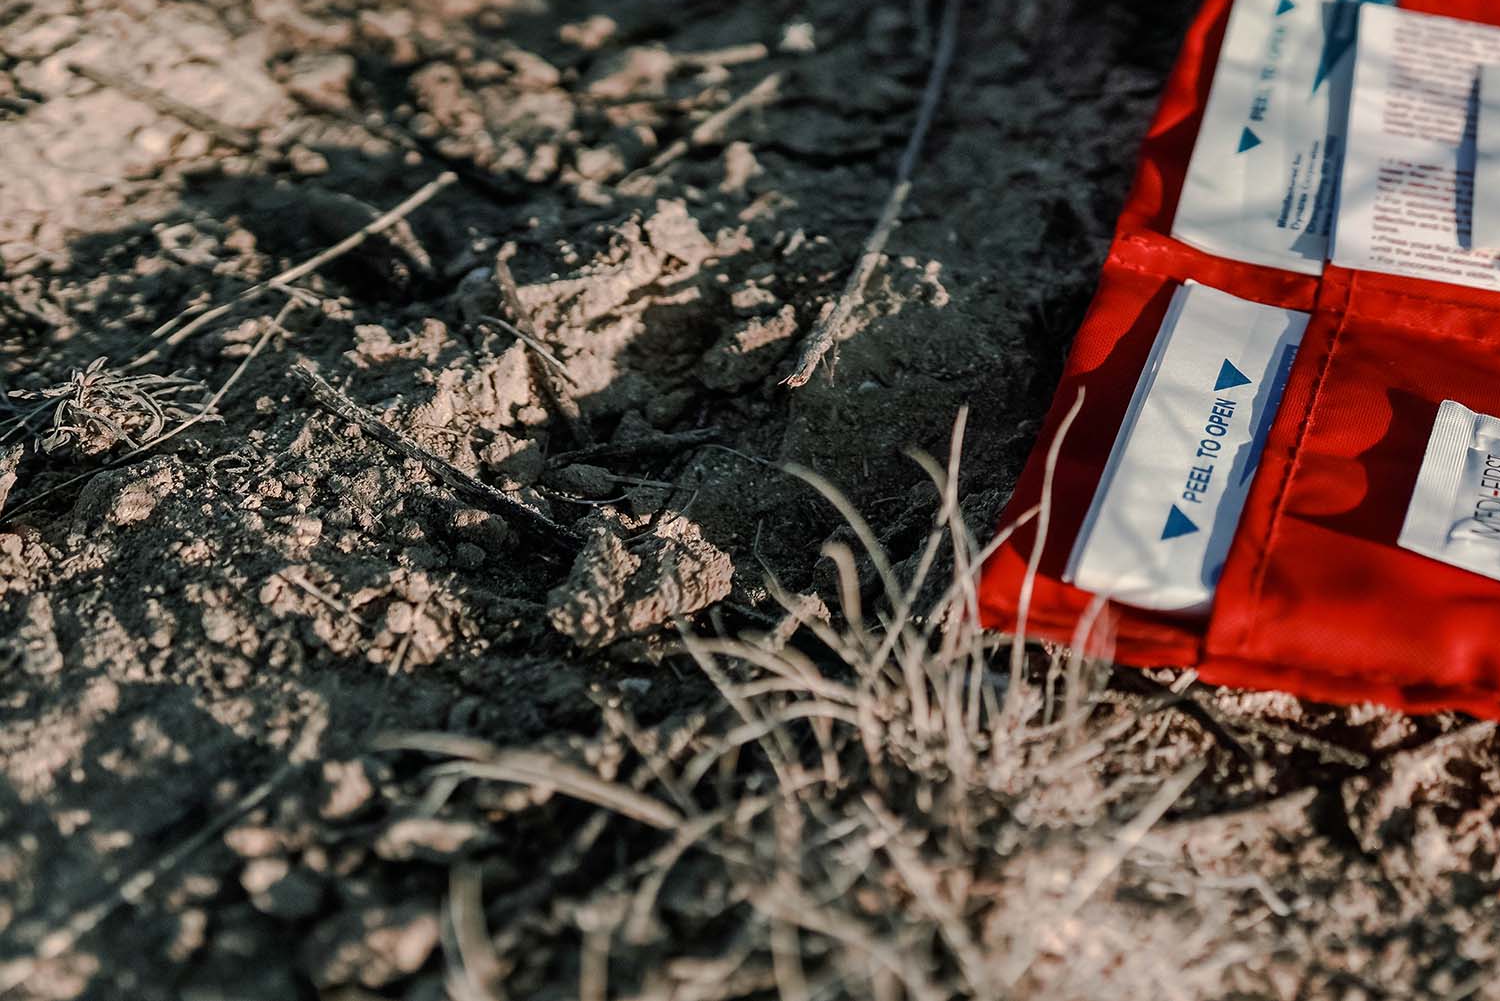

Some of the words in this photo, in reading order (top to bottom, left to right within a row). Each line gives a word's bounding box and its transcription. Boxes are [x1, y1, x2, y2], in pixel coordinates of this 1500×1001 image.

[1204, 397, 1237, 438] OPEN
[1196, 438, 1222, 459] TO
[1182, 464, 1215, 504] PEEL
